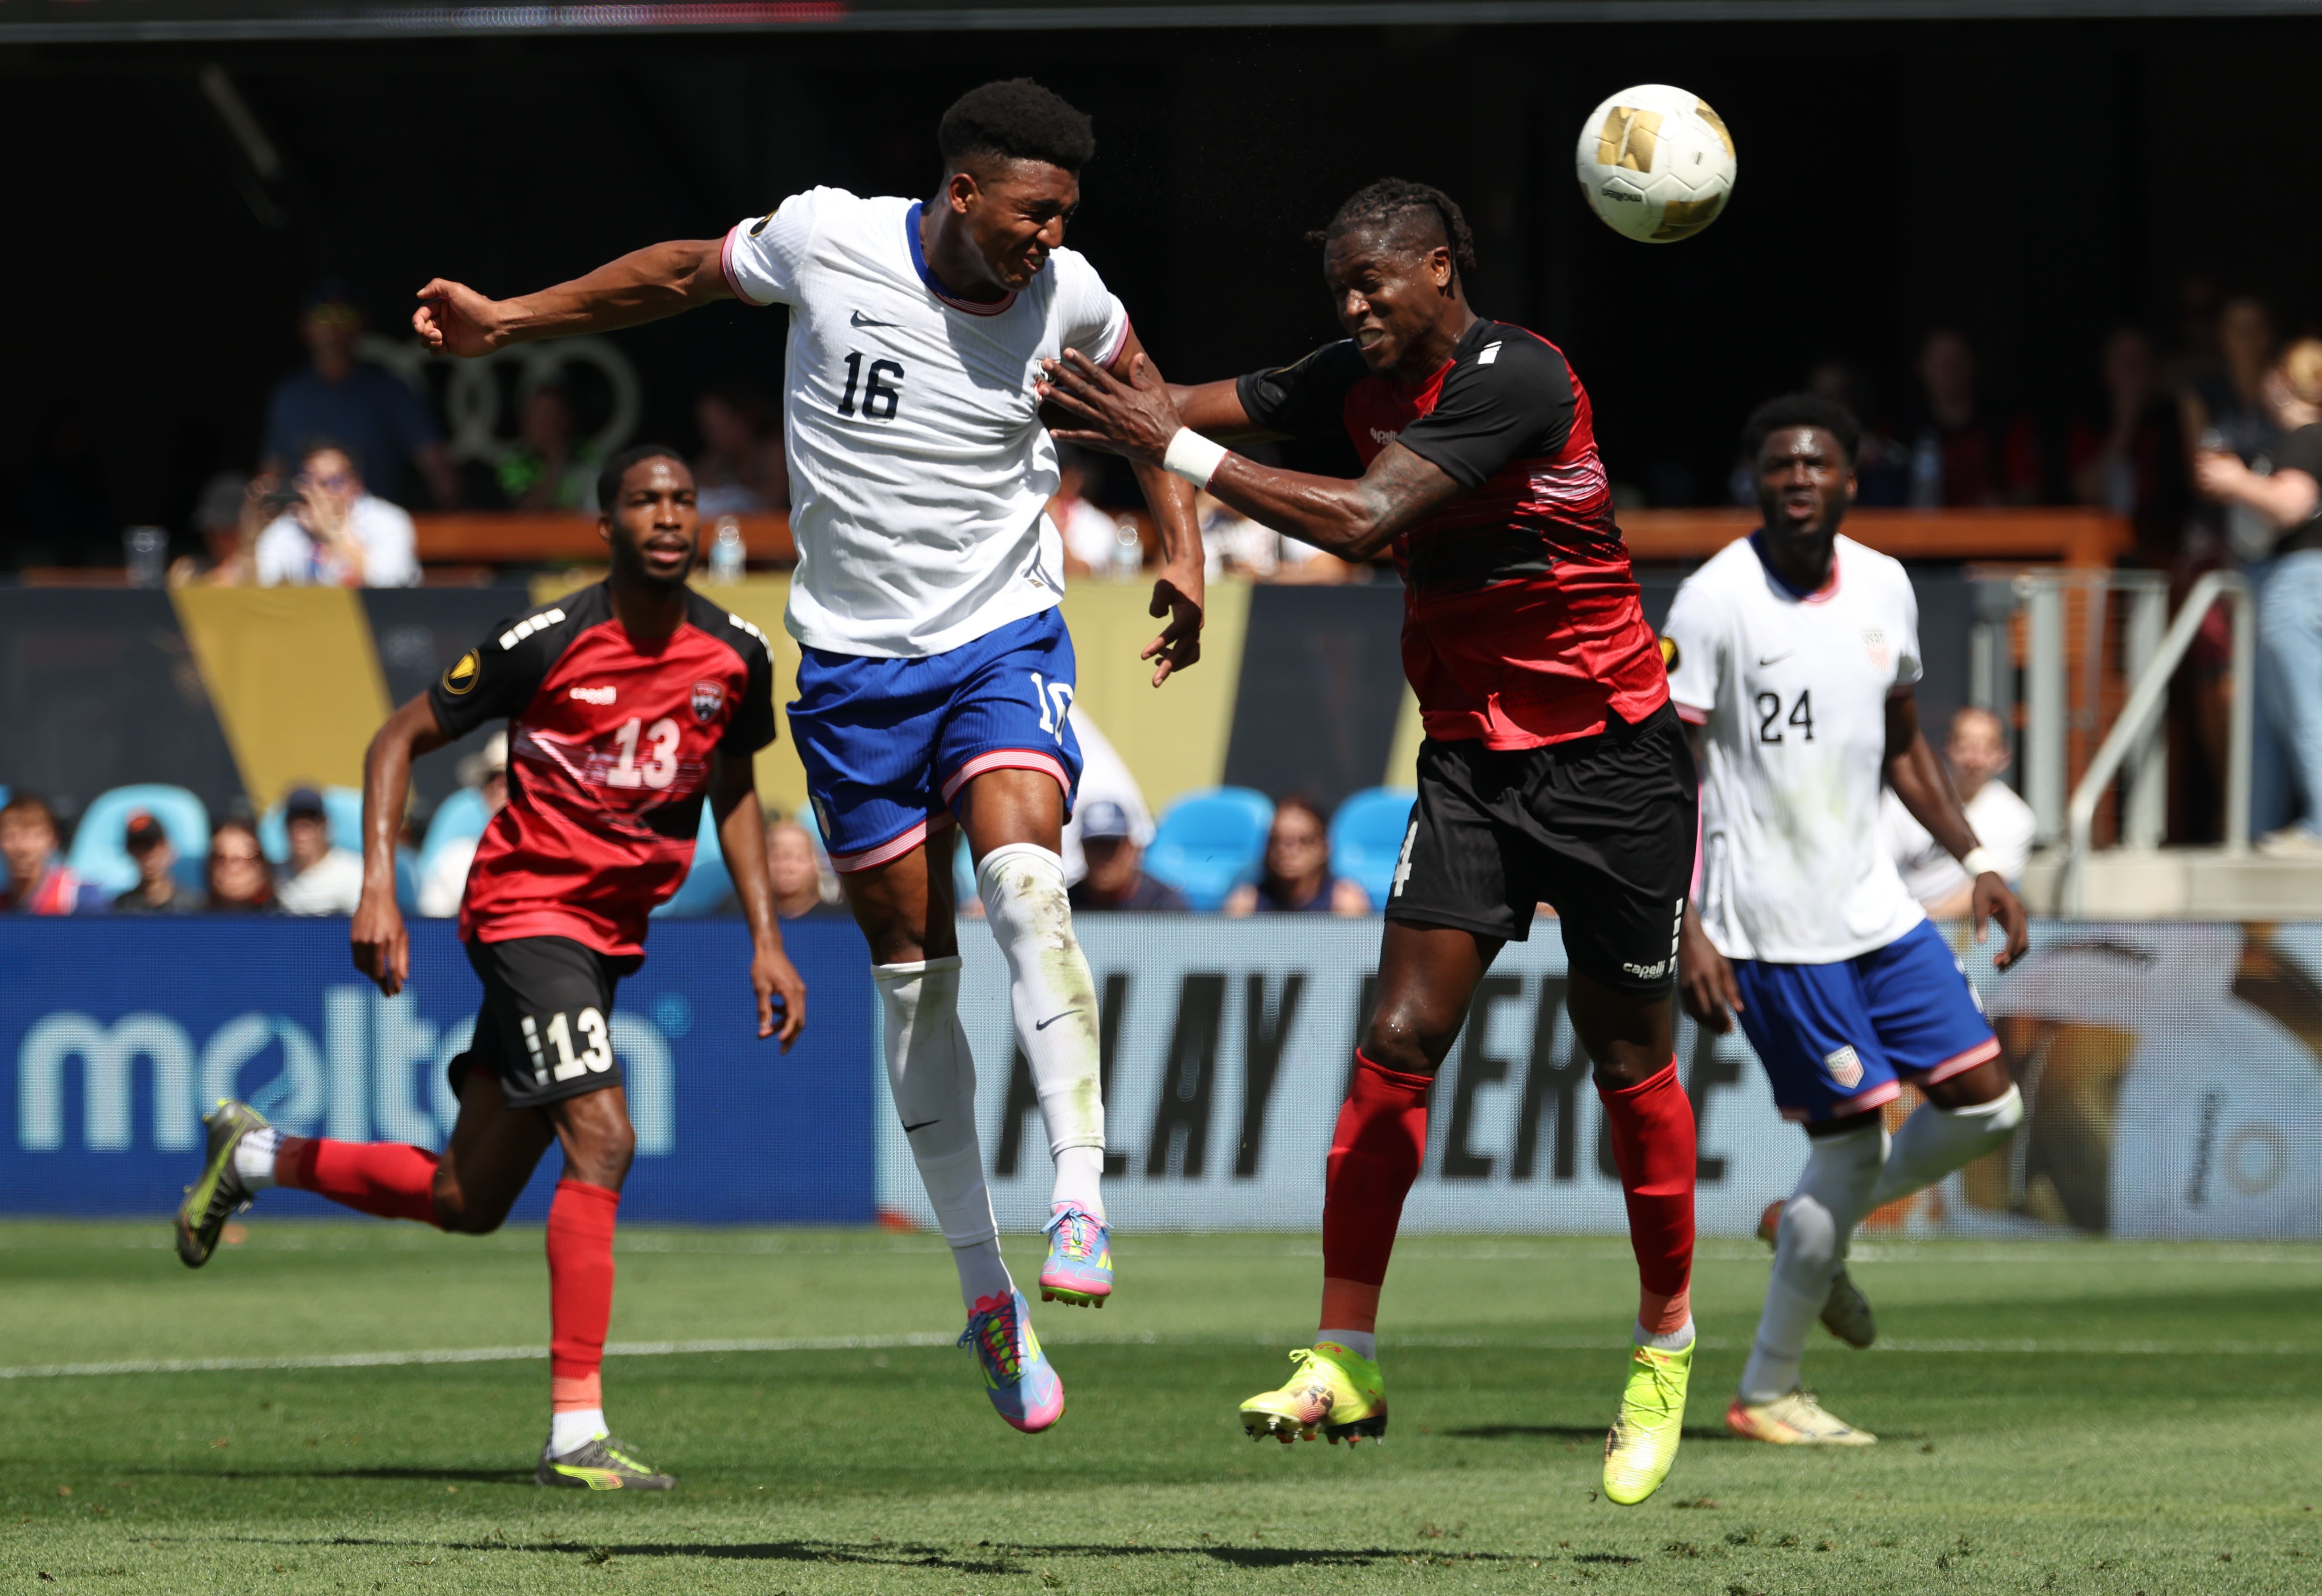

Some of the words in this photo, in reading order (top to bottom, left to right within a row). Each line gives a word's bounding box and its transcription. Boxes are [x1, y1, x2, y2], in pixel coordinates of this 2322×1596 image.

[838, 352, 904, 423] 16
[1757, 689, 1813, 742] 24
[607, 717, 680, 788] 13
[1622, 960, 1666, 978] capelli
[547, 1007, 613, 1082] 13
